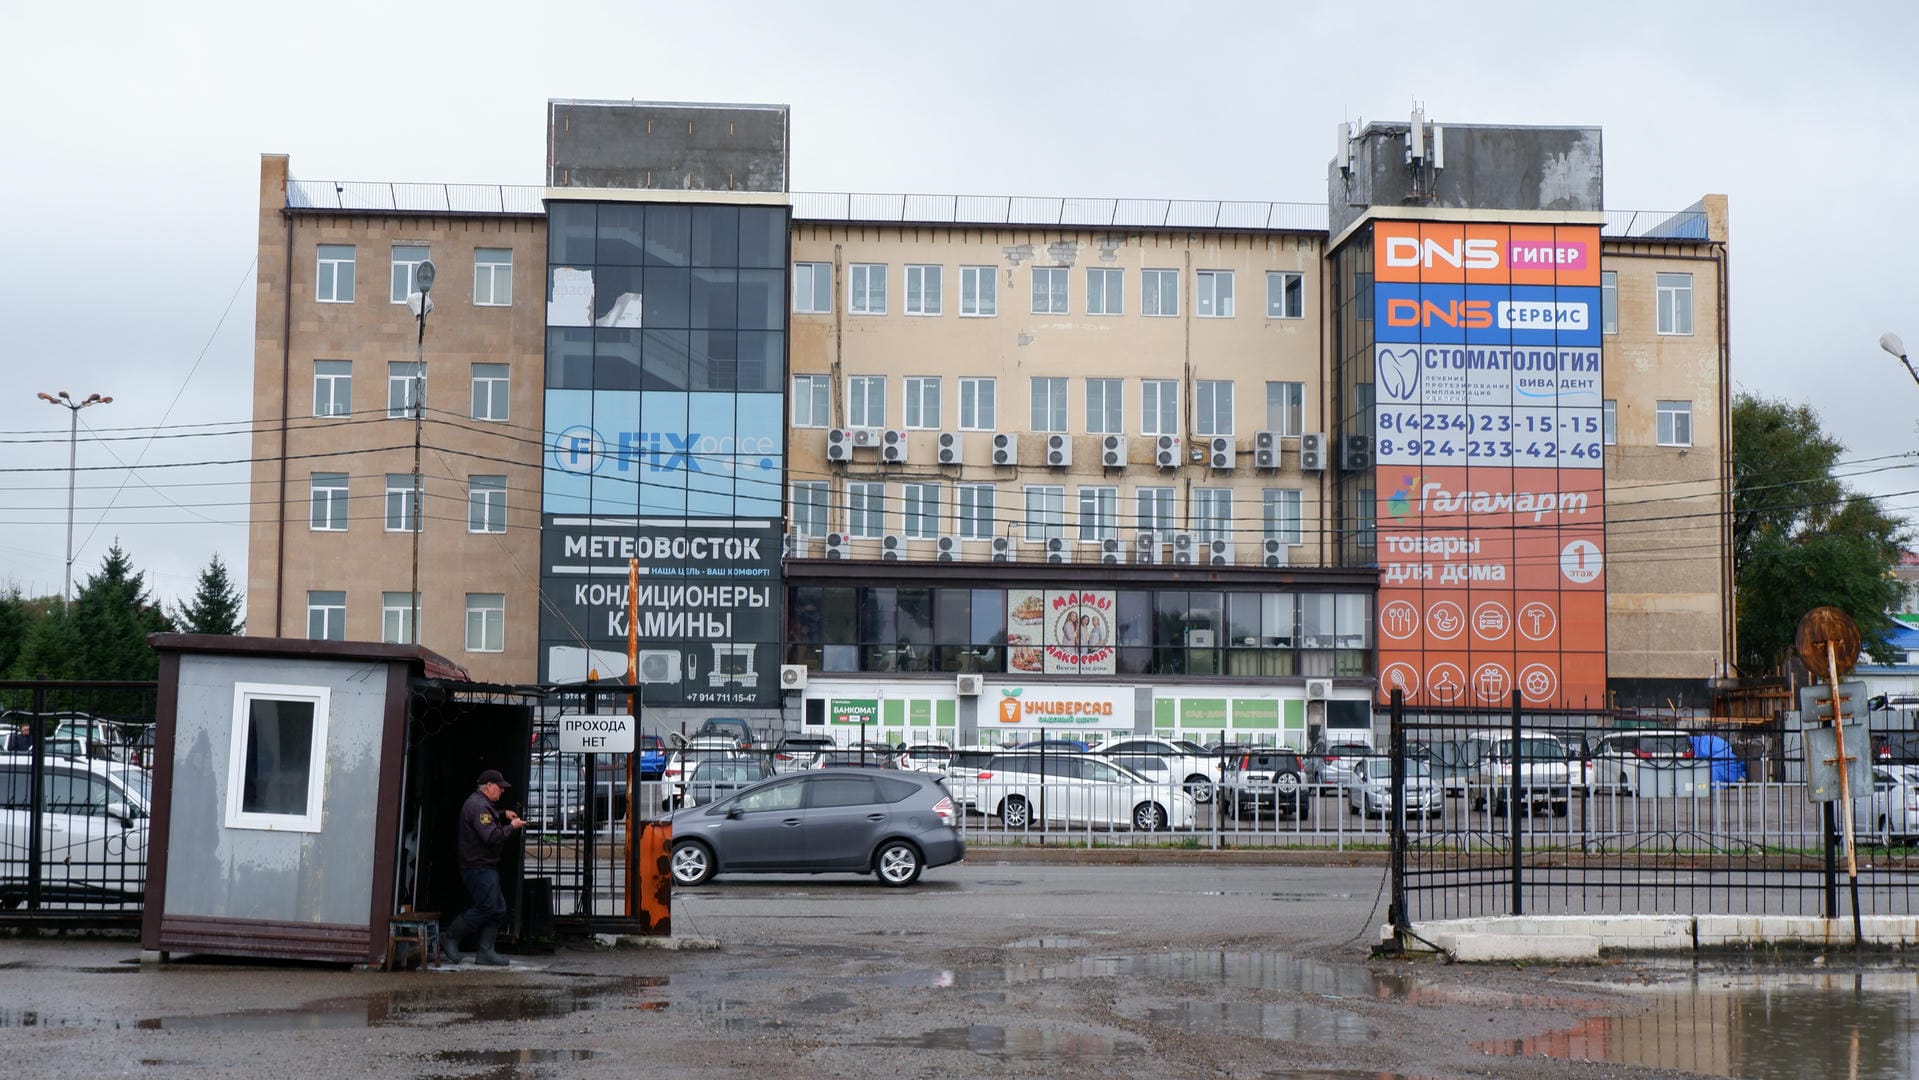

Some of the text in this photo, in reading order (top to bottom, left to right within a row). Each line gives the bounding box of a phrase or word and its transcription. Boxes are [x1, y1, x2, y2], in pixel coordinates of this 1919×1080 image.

[1386, 236, 1500, 269] DNS
[1512, 246, 1579, 264] ГИПЕР
[1387, 298, 1493, 328] DNS
[1506, 308, 1581, 323] СЕРВИС
[1424, 348, 1599, 372] СТОМАТОЛОГИЯ
[1425, 382, 1510, 390] ПРОТЕЗИРОВАНИЕ
[1519, 378, 1595, 390] ВИВА ДЕНТ
[1379, 412, 1598, 435] 8(4234)23-15-15
[1379, 439, 1601, 459] 8-924-233-42-46
[1418, 482, 1588, 522] Галамарт
[564, 535, 761, 560] МЕТЕОВОСТОК
[1385, 535, 1481, 560] товары
[1573, 545, 1585, 569] 1
[651, 567, 676, 575] НАША
[678, 567, 700, 576] ЦЕЛЬ
[706, 568, 726, 576] ВАШ
[1385, 562, 1506, 584] для дома
[1570, 570, 1593, 578] этаж
[575, 584, 770, 610] КОНДИЦИОНЕРЫ
[1053, 593, 1112, 611] МАМЫ
[608, 611, 732, 638] КАМИНЫ
[687, 693, 698, 702] +7
[699, 693, 714, 702] 914
[834, 706, 876, 714] БАНКОМАТ
[1025, 701, 1113, 716] УНИВЕРСАД
[566, 720, 626, 732] ПРОХОДА
[582, 737, 606, 747] НЕТ
